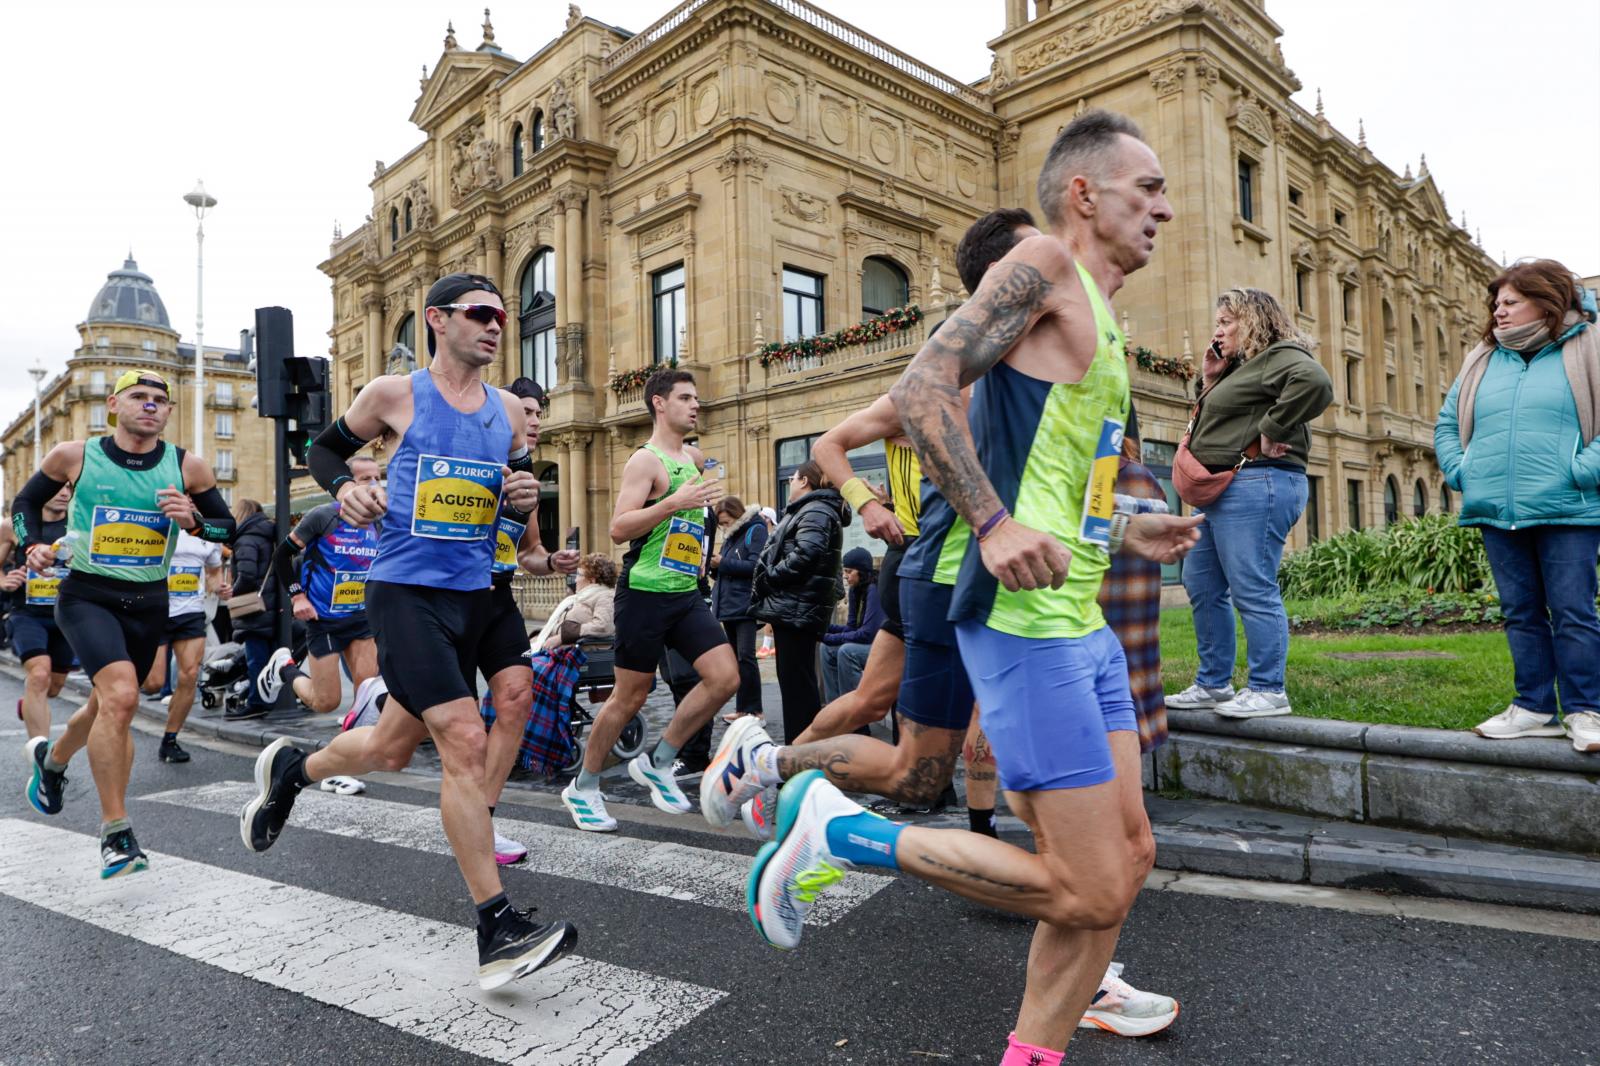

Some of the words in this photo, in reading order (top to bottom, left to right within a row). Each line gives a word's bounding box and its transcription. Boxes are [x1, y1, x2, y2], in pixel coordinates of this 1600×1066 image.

[454, 465, 494, 479] ZURICH
[432, 492, 495, 509] AGUSTIN
[123, 513, 160, 524] ZURICH
[453, 511, 472, 523] 592
[102, 536, 133, 544] JOSEP
[122, 547, 140, 555] 522
